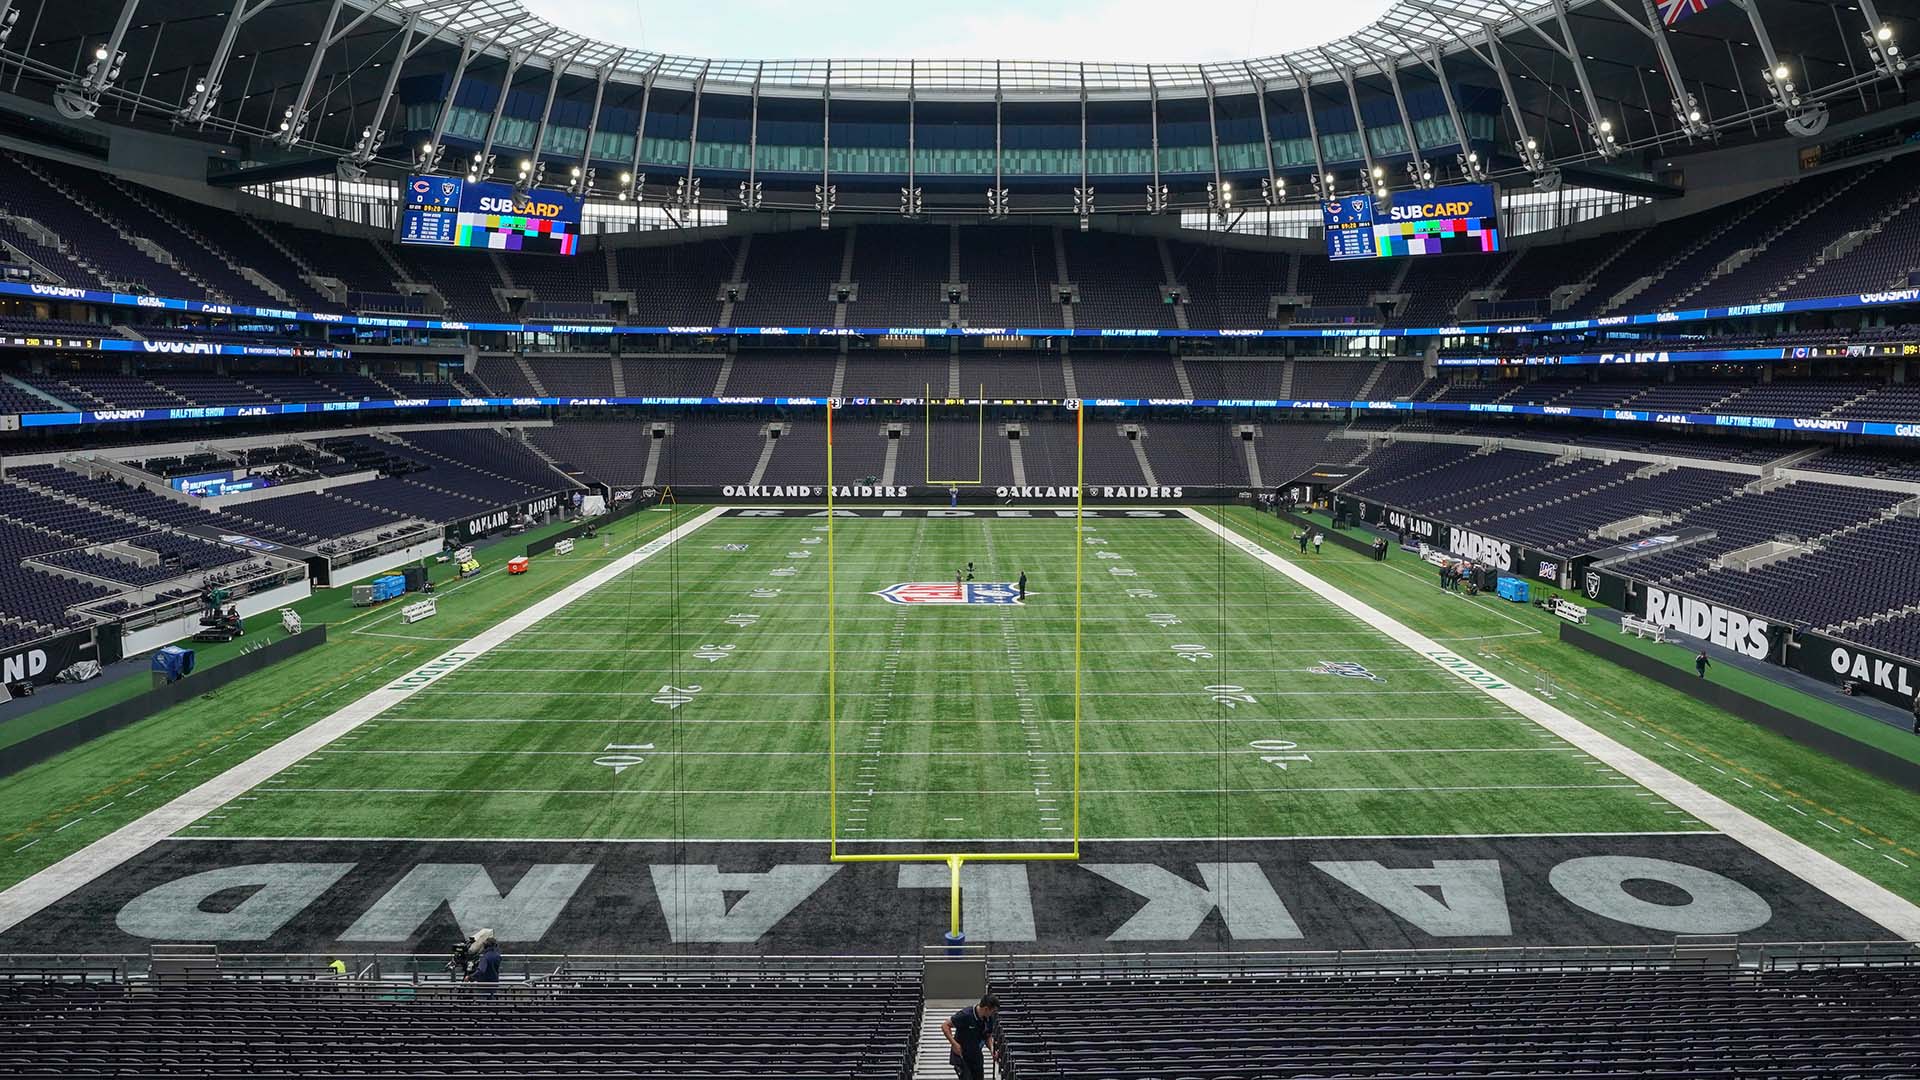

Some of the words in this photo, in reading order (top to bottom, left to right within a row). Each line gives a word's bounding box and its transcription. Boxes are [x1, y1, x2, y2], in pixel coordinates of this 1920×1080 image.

[1390, 202, 1470, 220] SUBCARD
[1728, 304, 1761, 316] HALFTIME
[1762, 302, 1785, 312] SHOW
[358, 317, 387, 326] HALFTIME
[388, 319, 408, 327] SHOW
[552, 325, 590, 333] HALFTIME
[591, 326, 613, 334] SHOW
[87, 340, 92, 348] 5
[1811, 348, 1818, 357] 0
[1869, 347, 1875, 355] 7
[170, 408, 205, 419] HALFTIME
[205, 407, 225, 417] SHOW
[1716, 415, 1751, 427] HALFTIME
[1752, 417, 1775, 428] SHOW
[722, 485, 810, 497] OAKLAND
[829, 486, 907, 497] RAIDERS
[996, 486, 1083, 498] OAKLAND
[1104, 487, 1183, 498] RAIDERS
[528, 495, 557, 516] RAIDERS
[1450, 528, 1512, 571] RAIDERS
[1646, 587, 1769, 660] RAIDERS
[693, 644, 736, 658] 30
[1171, 644, 1214, 660] 30
[3, 649, 47, 684] ND
[387, 651, 476, 690] LONDON
[1426, 651, 1512, 690] LONDON
[1830, 647, 1913, 696] OAKL
[651, 685, 702, 704] 20
[1204, 685, 1257, 705] 20
[593, 742, 655, 766] 10
[1249, 740, 1312, 764] 10
[115, 855, 1773, 943] OAKLAND
